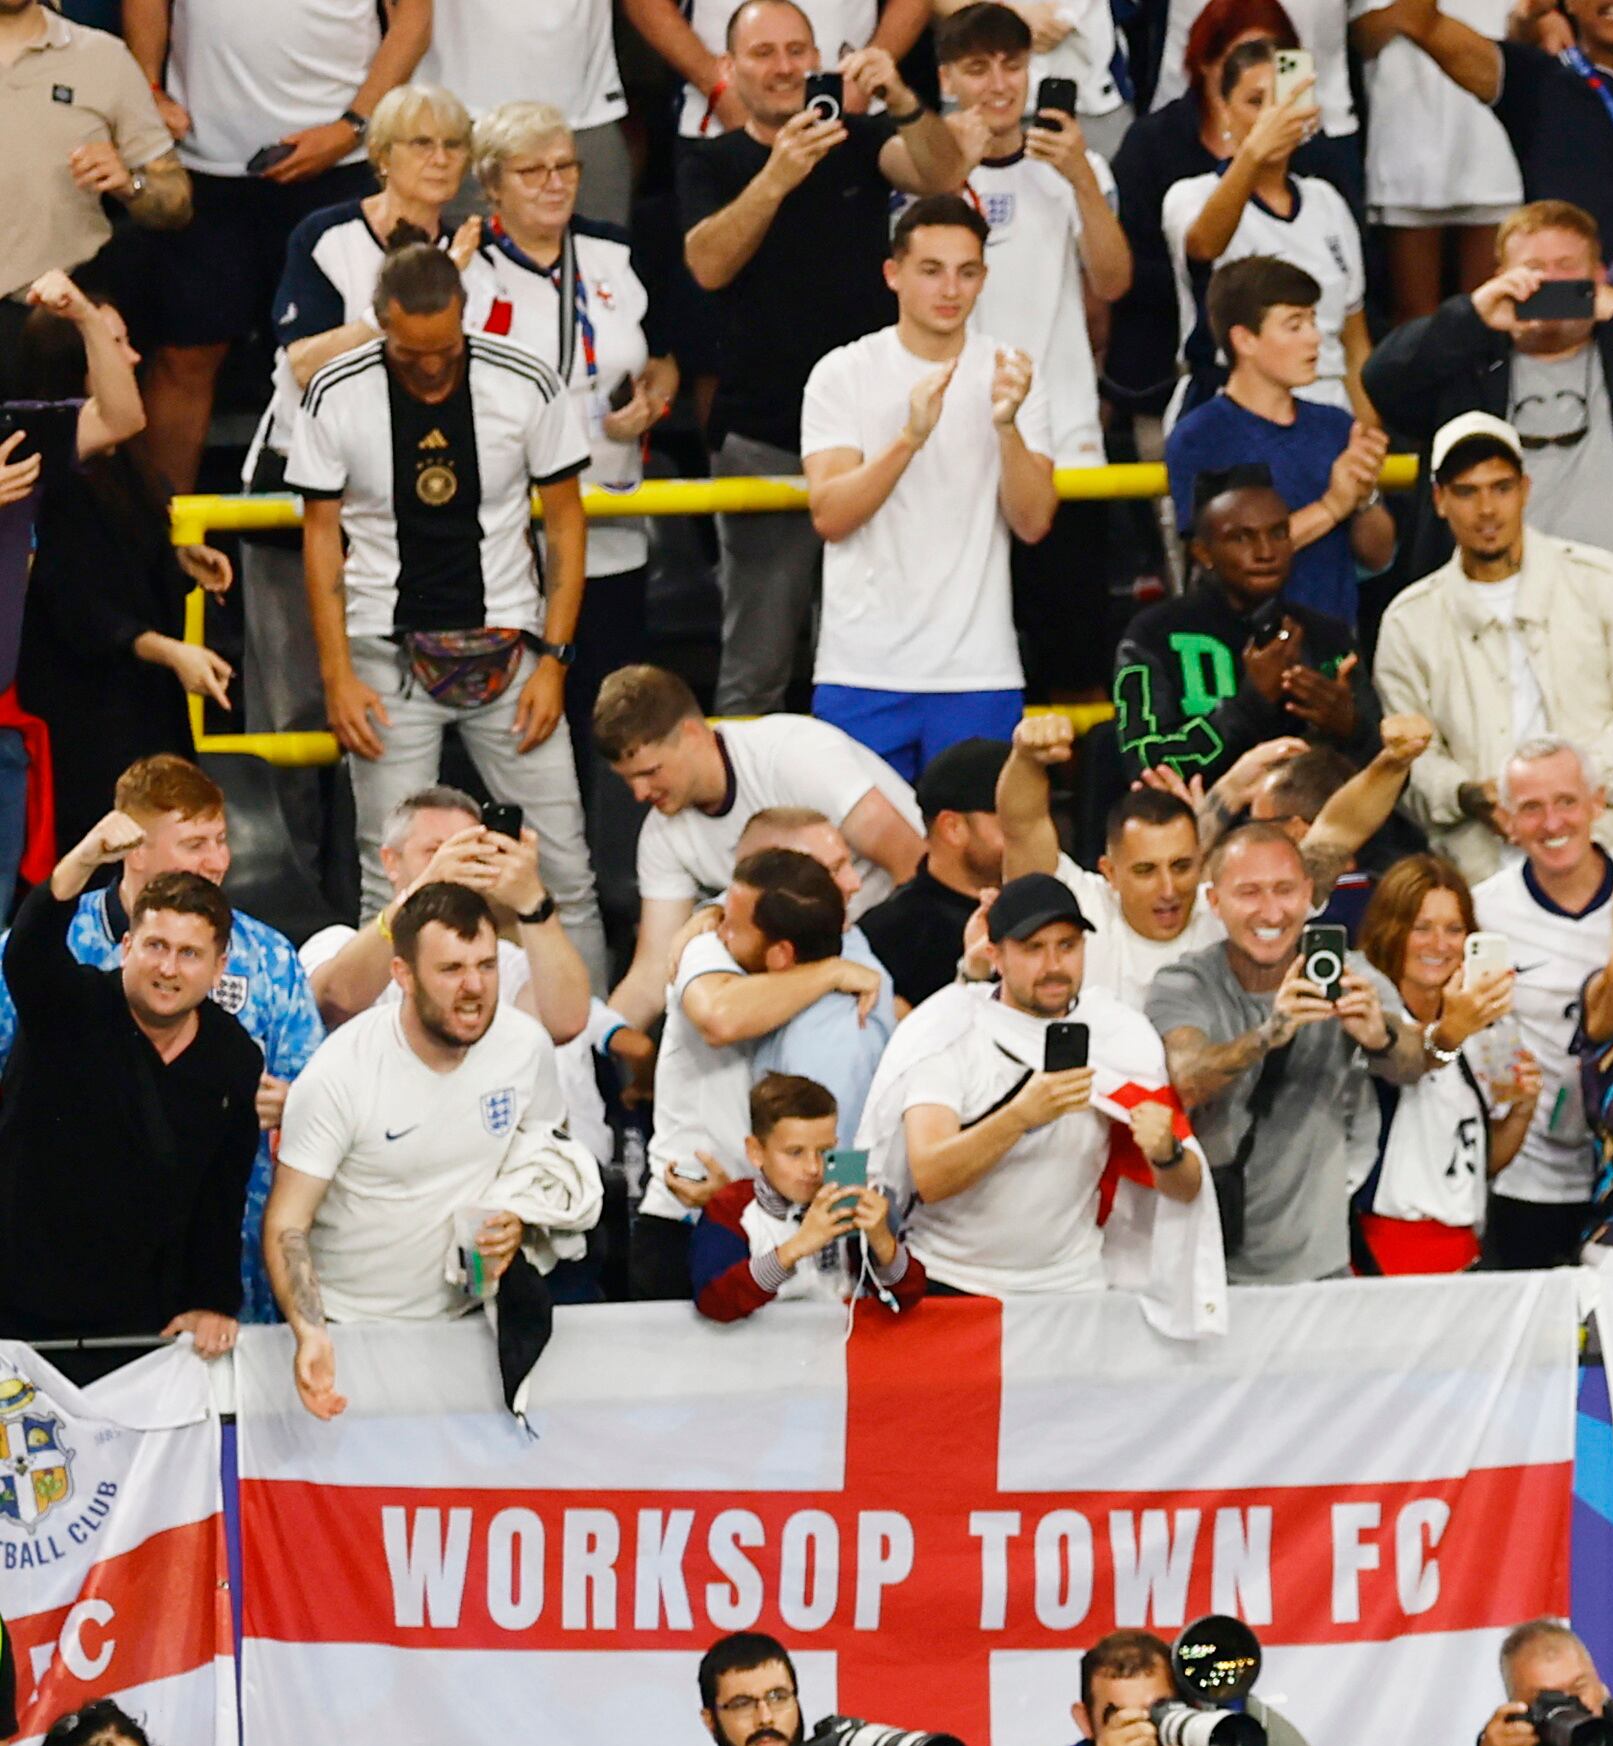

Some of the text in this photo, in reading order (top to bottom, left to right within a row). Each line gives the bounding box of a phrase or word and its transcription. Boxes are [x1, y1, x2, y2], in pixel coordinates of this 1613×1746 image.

[0, 1480, 117, 1569] BALL CLUB
[380, 1497, 1451, 1635] WORKSOP TOWN FC
